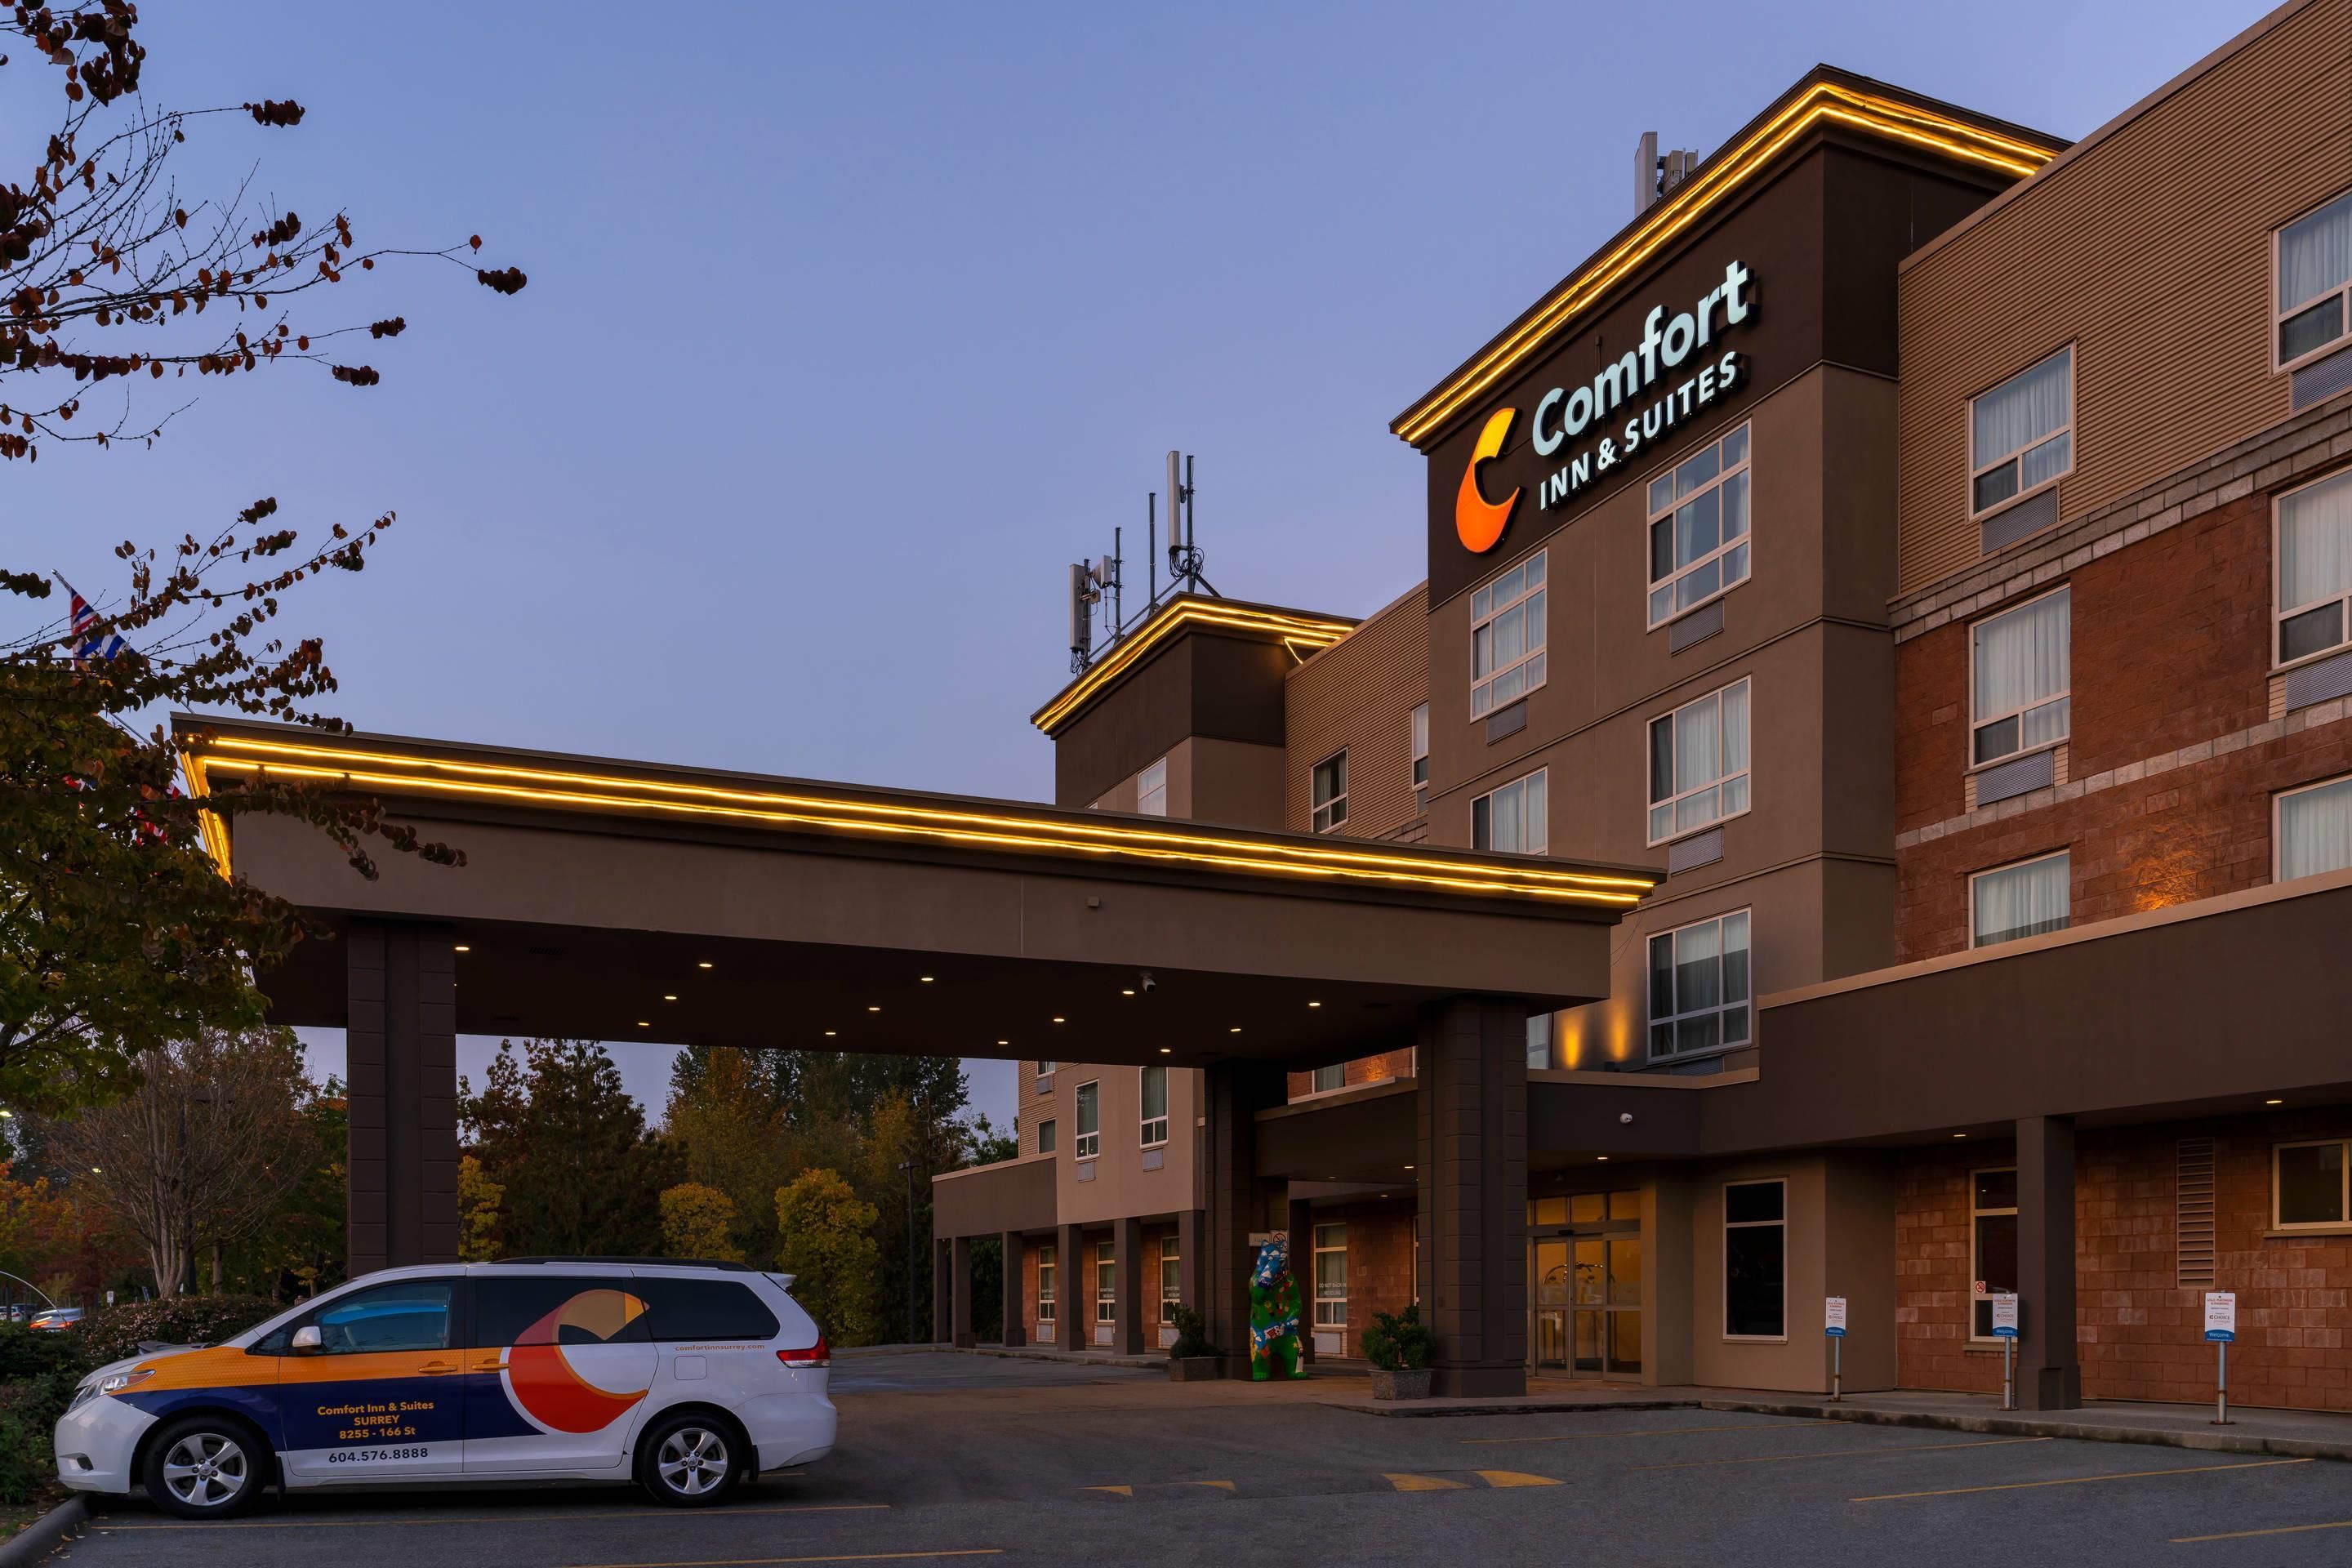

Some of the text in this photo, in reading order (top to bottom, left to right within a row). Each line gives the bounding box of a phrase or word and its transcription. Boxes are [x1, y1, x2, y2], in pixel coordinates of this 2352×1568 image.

[1532, 260, 1749, 457] Comfort
[1540, 351, 1738, 510] INN & SUITES
[317, 1401, 434, 1415] Comfort Inn & Suites
[354, 1414, 400, 1426] SURREY
[339, 1429, 369, 1440] 8255
[380, 1427, 402, 1437] 166
[404, 1427, 416, 1435] St
[328, 1447, 429, 1463] 604.576.8888
